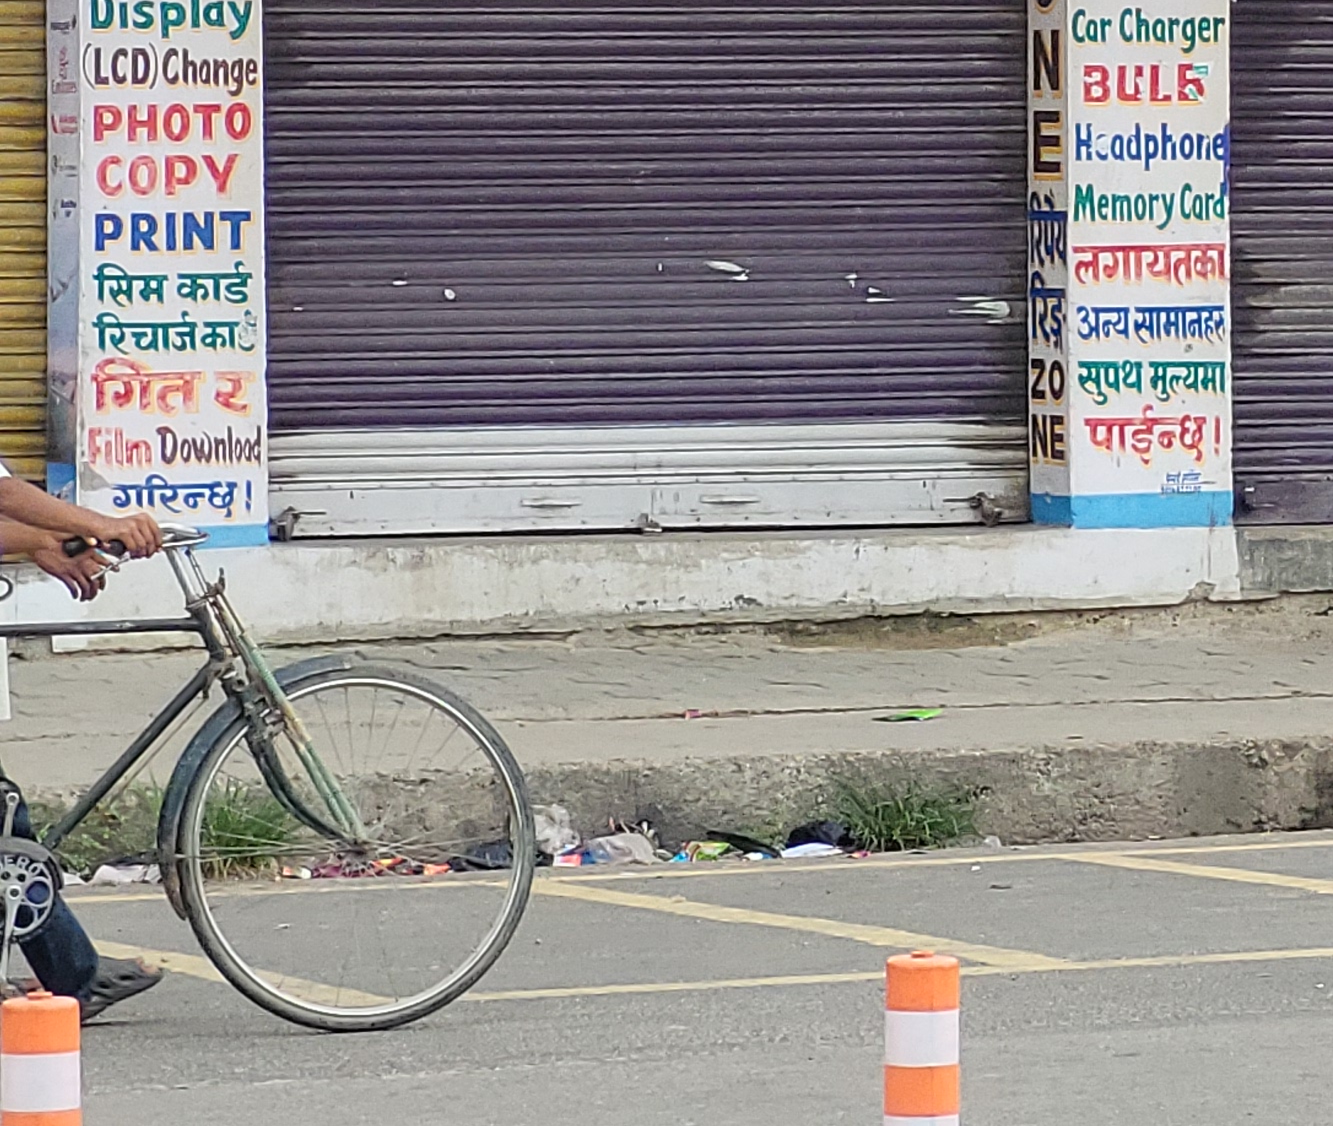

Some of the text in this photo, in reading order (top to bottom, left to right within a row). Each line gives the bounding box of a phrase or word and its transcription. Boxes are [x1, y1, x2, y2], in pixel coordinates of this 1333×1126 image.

[1071, 7, 1226, 55] Car Charger
[92, 102, 252, 143] PHOTO
[95, 153, 240, 197] COPY
[1073, 182, 1226, 230] Memory Card
[94, 210, 253, 252] PRINT
[92, 260, 253, 307] सिम कार्ड
[92, 310, 197, 355] रिचार्ज
[1075, 304, 1131, 340] अन्य
[91, 356, 252, 413] गित र
[1077, 359, 1226, 406] सुपथ मुल्यमा
[87, 427, 153, 468] Film
[1084, 404, 1207, 466] पाईन्छ
